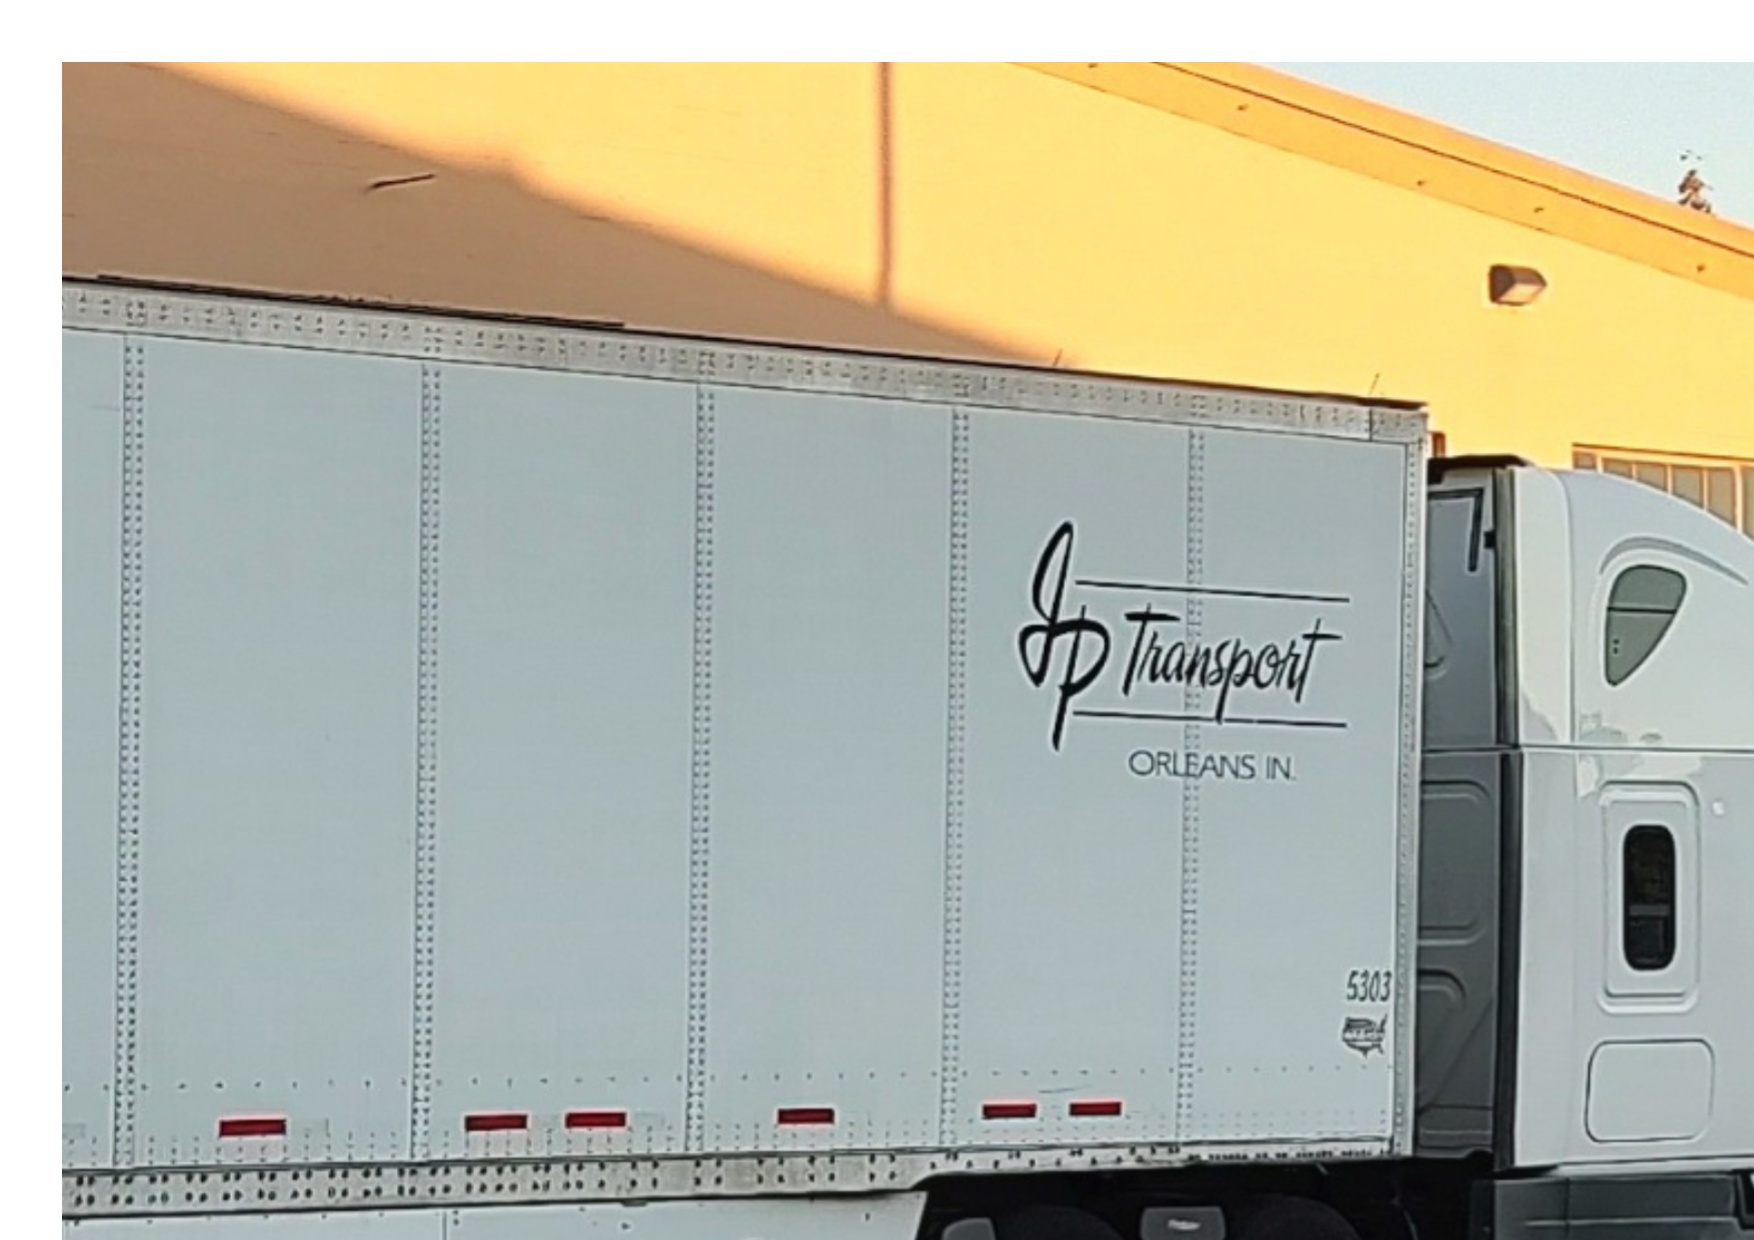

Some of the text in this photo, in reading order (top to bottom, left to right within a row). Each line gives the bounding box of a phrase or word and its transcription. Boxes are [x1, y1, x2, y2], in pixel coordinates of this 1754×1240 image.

[1018, 520, 1344, 752] JP Transport
[1346, 969, 1393, 1003] 5303
